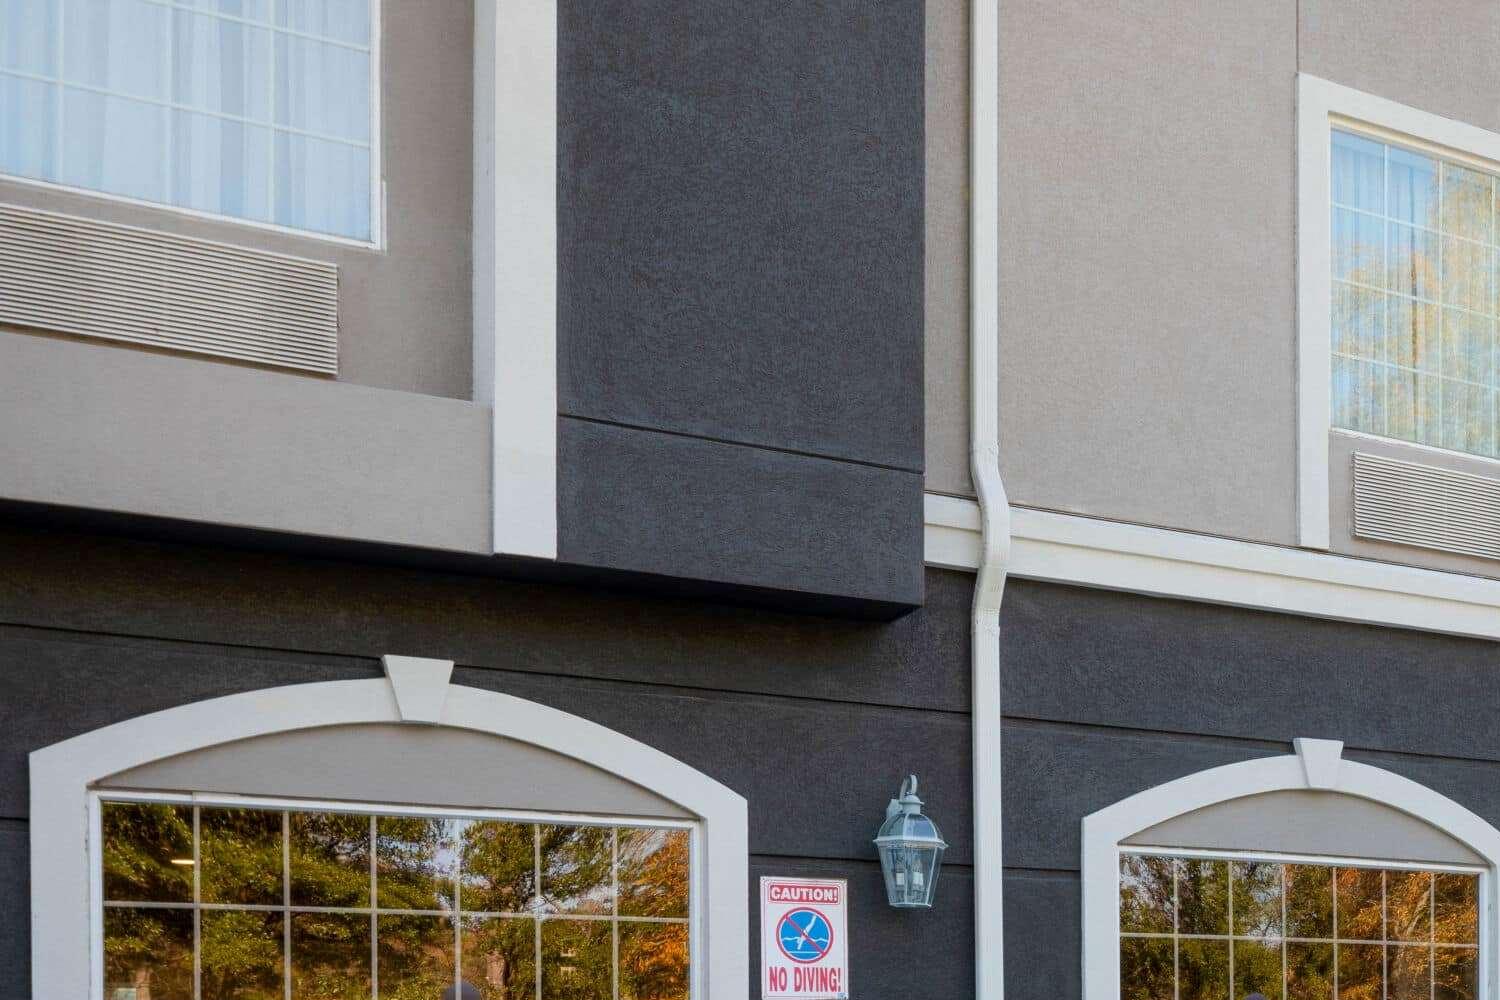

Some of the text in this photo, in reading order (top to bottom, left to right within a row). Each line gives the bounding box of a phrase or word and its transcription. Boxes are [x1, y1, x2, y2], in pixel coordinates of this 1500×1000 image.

[770, 886, 838, 902] CAUTION!
[768, 966, 842, 993] NO DIVING!
